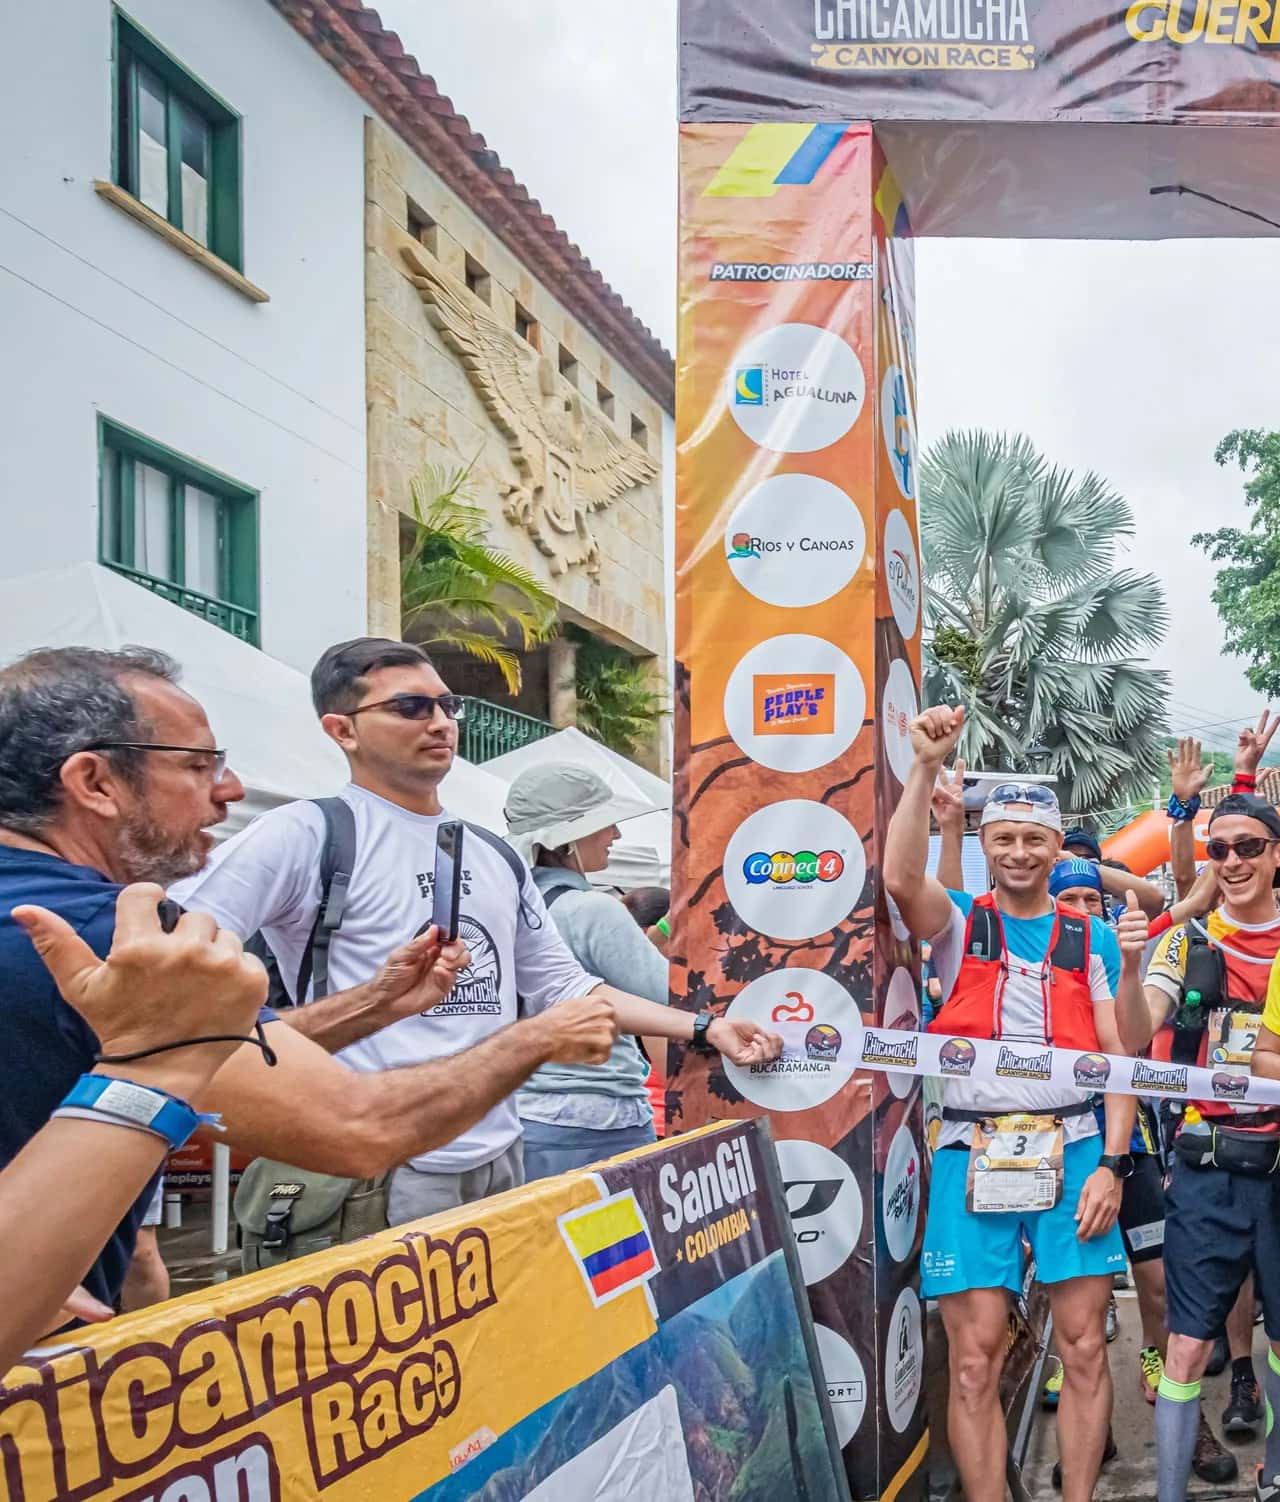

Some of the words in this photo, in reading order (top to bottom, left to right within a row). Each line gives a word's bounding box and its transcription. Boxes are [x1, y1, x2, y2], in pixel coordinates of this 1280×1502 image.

[815, 0, 1029, 41] CHICAMOCHA
[835, 47, 942, 66] CANYON
[949, 47, 1012, 67] RACE
[771, 368, 808, 381] HOTEL
[773, 387, 857, 403] AGUALUNA
[750, 537, 774, 552] RIOS
[799, 537, 855, 552] CANOAS
[764, 687, 825, 710] PEOPLE
[764, 702, 819, 723] PLAY'S
[750, 856, 822, 877] Connect
[823, 857, 838, 876] 4
[416, 870, 473, 886] PEE
[441, 970, 500, 1003] ICAMOCHA
[433, 1004, 475, 1015] CANYON
[477, 1003, 496, 1014] RACE
[864, 1032, 918, 1059] CHICAMOCHA
[750, 1063, 831, 1074] BUCARAMANGA
[998, 1046, 1053, 1073] CHICAMOCHA
[1133, 1062, 1188, 1086] CHICAMOCHA
[1012, 1135, 1028, 1156] 3
[659, 1135, 757, 1233] SanGil
[684, 1208, 750, 1264] COLOMBIA
[0, 1232, 495, 1502] hicamocha
[312, 1345, 457, 1478] Race
